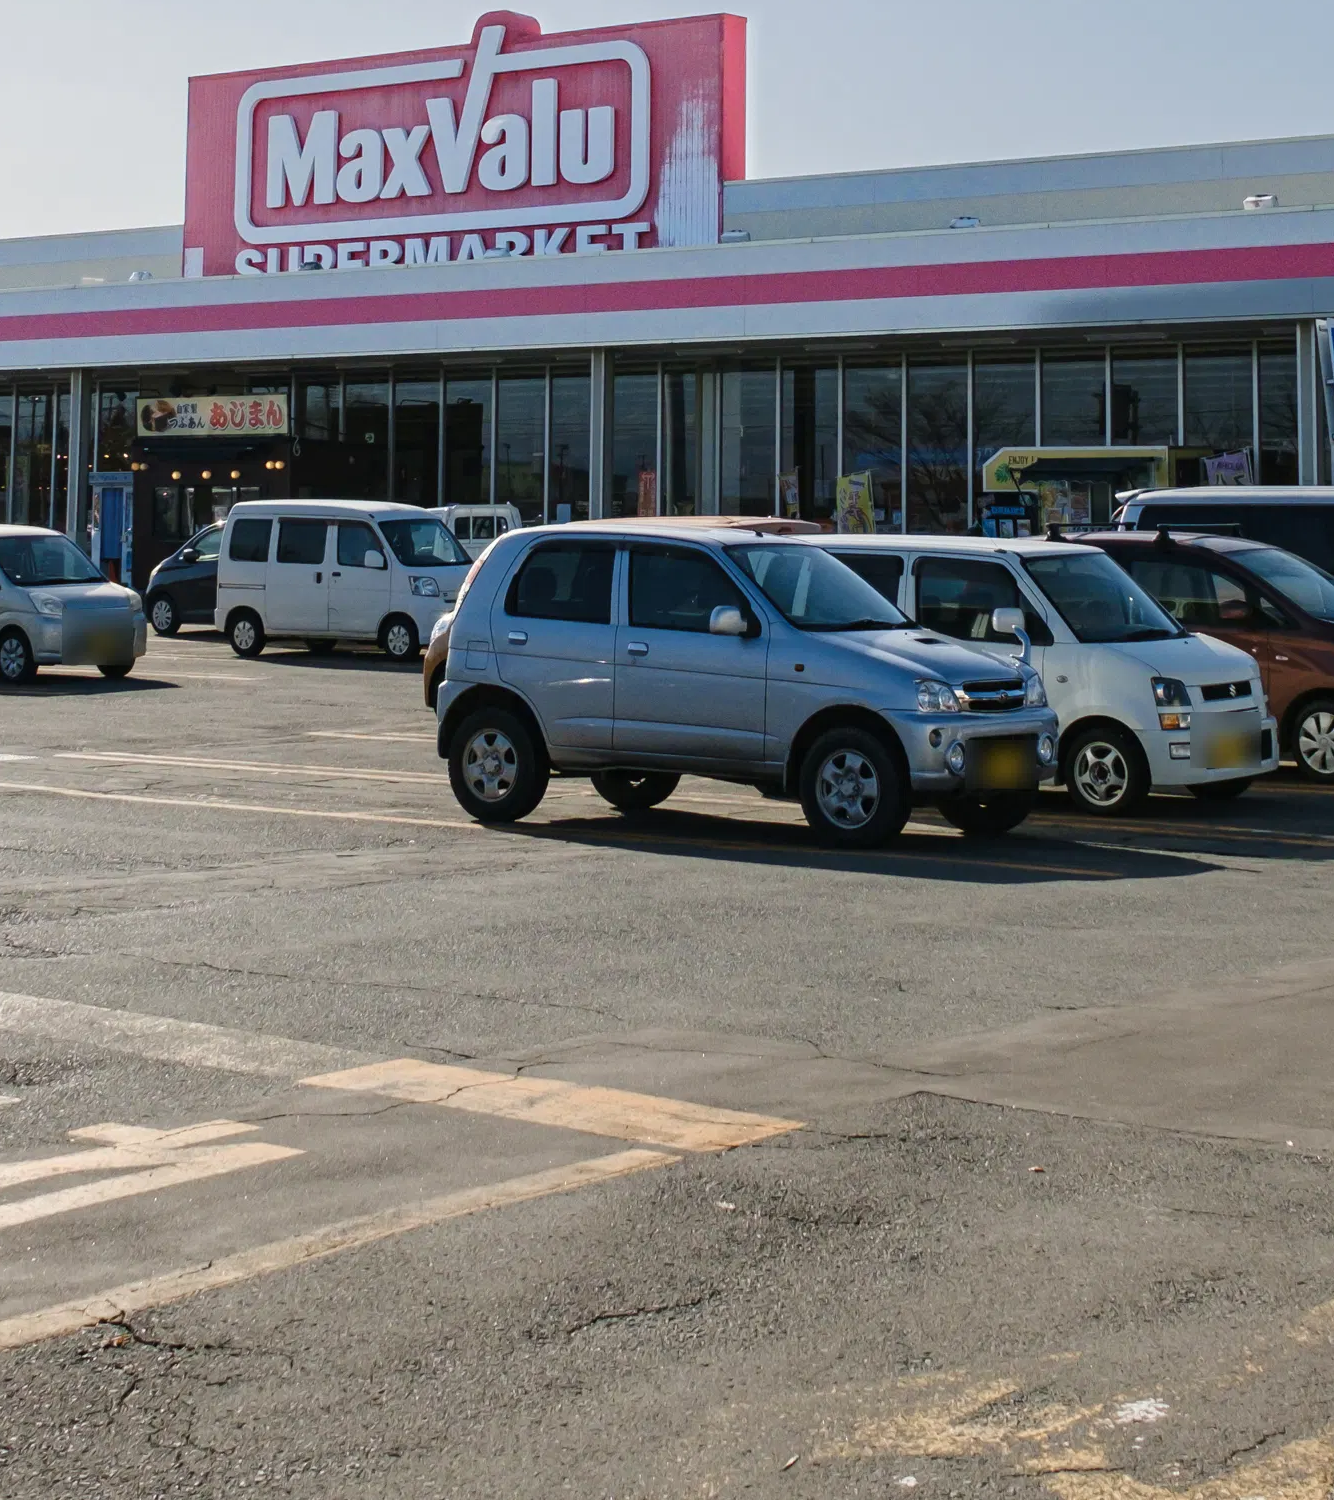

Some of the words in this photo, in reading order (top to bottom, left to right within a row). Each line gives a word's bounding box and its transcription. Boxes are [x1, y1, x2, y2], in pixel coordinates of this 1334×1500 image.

[266, 25, 615, 209] MaxValu
[168, 417, 205, 429] つぶあん
[209, 399, 284, 431] あじまん
[1008, 455, 1029, 466] ENJOY
